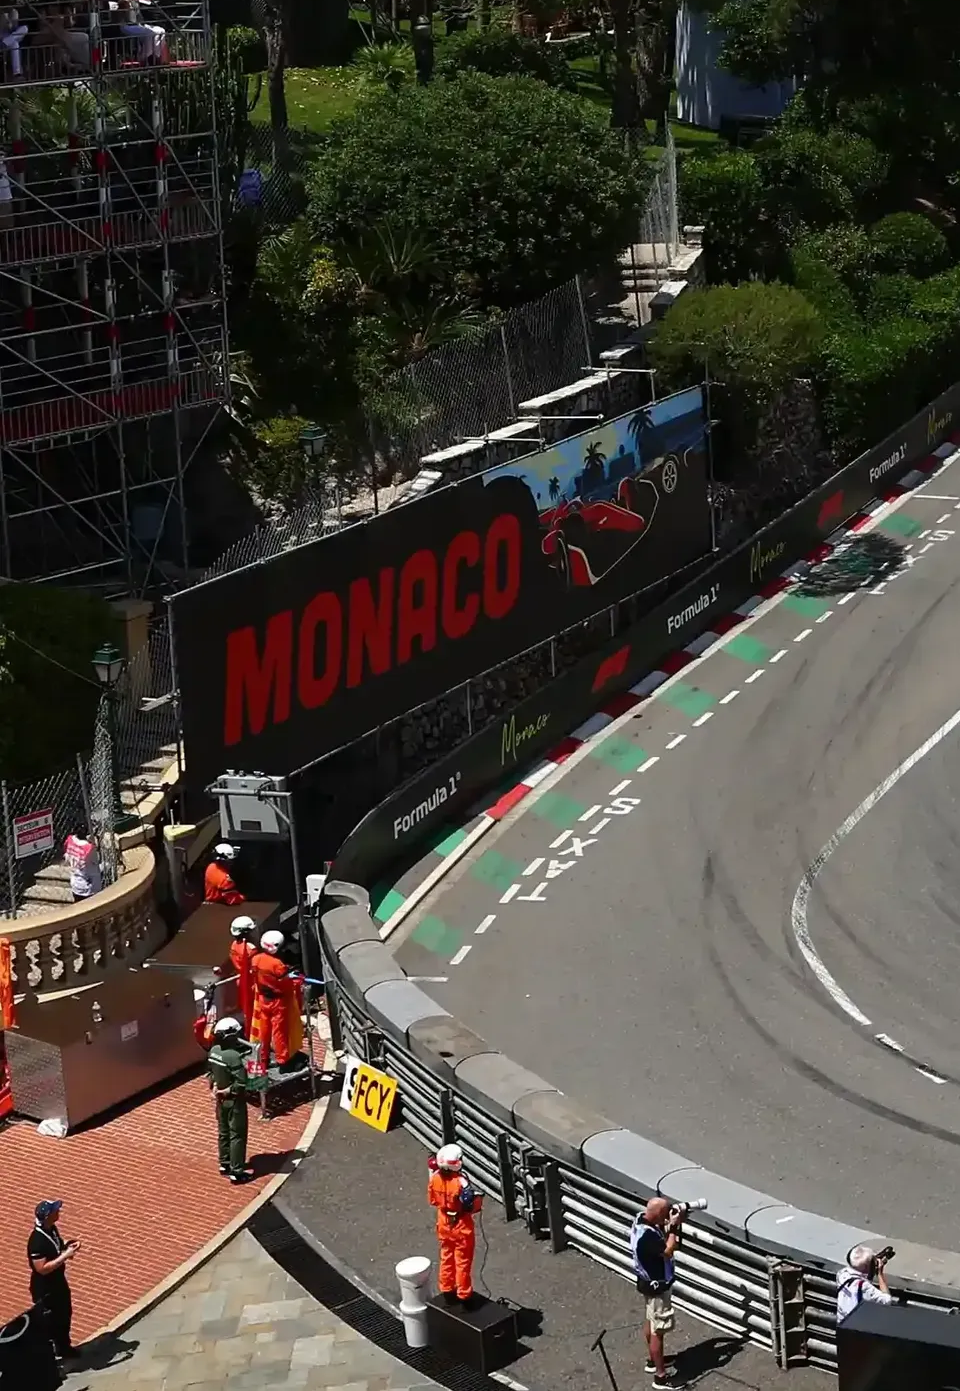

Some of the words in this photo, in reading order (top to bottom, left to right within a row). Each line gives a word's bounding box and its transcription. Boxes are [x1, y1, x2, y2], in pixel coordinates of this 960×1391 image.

[869, 451, 900, 483] Formula
[224, 514, 521, 747] MONACO
[667, 594, 711, 634] Formula
[501, 713, 550, 766] Monaco
[393, 787, 448, 839] Formula
[516, 797, 642, 901] TAXIS
[355, 1074, 391, 1121] FCY
